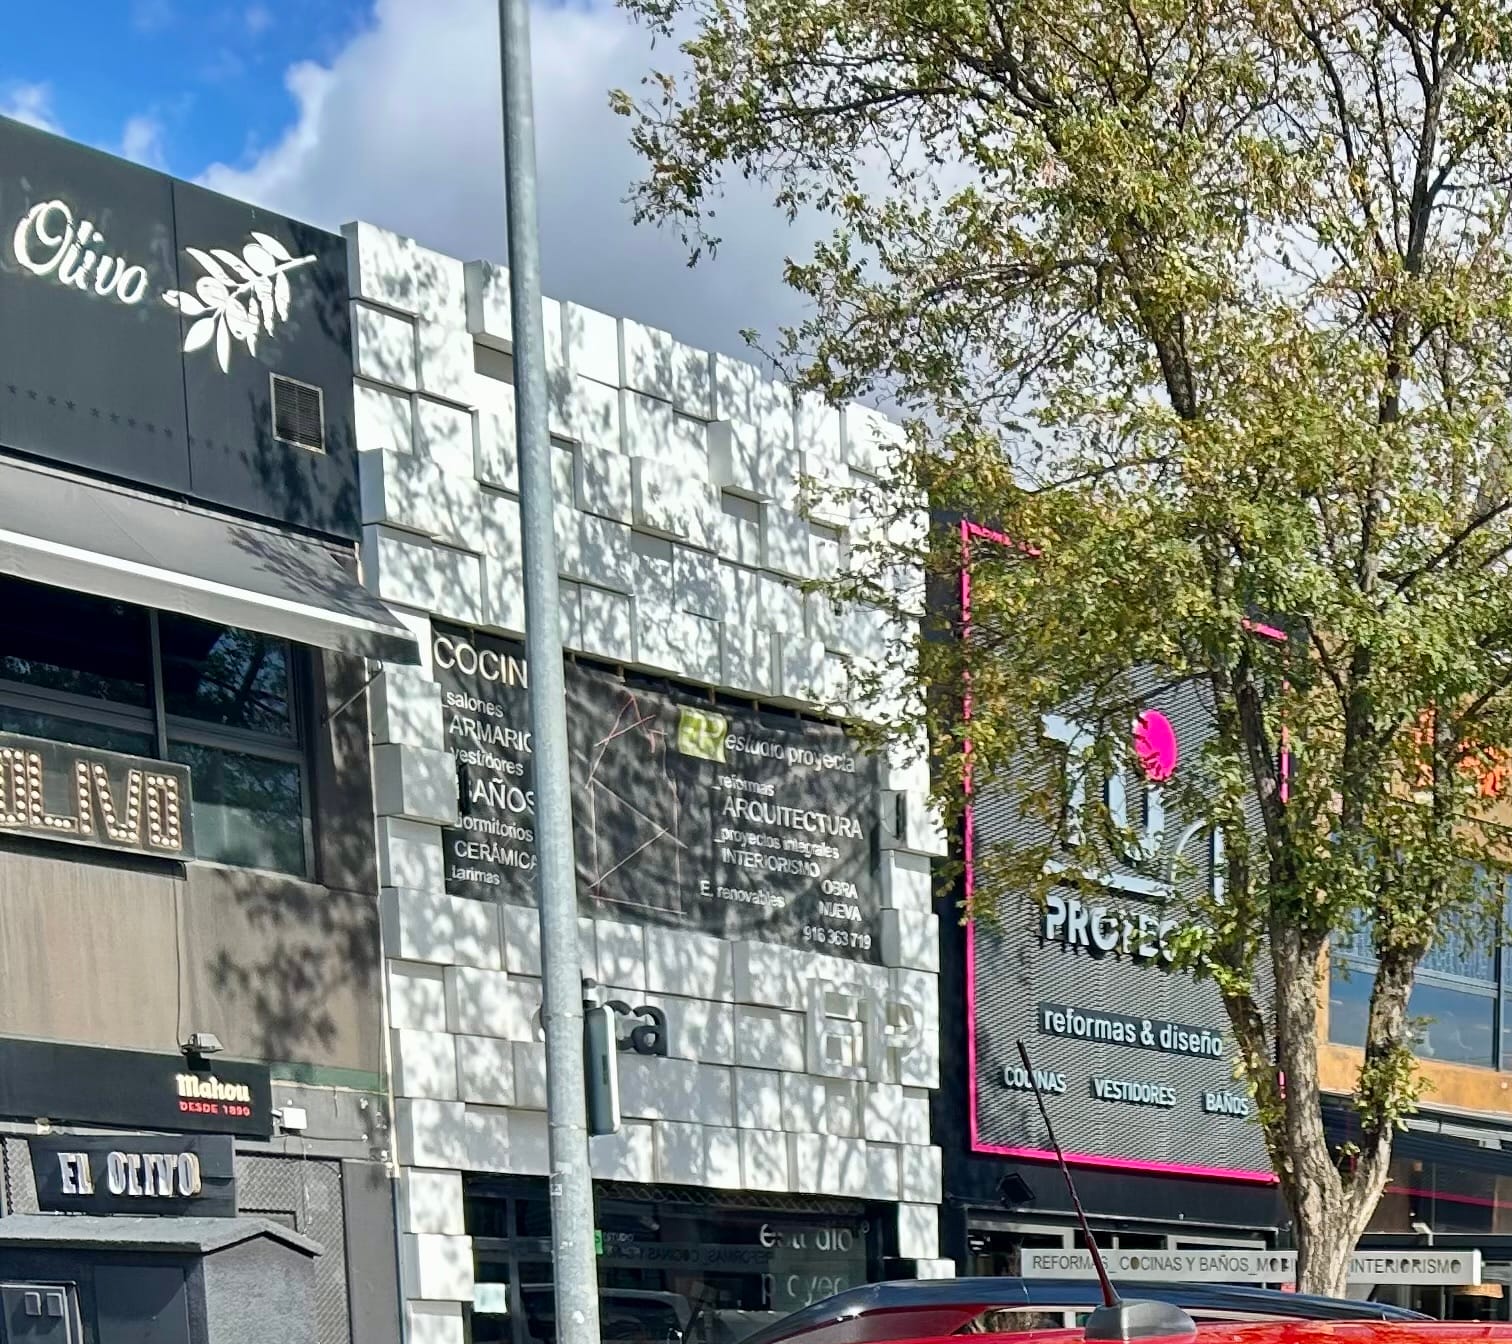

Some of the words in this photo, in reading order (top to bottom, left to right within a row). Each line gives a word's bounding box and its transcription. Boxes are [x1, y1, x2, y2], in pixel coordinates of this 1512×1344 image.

[13, 199, 148, 304] Olivo
[434, 637, 528, 689] COCIN
[450, 715, 533, 752] ARMARI
[468, 778, 535, 815] AÑOS
[722, 796, 864, 840] ARQUITECTURA
[721, 848, 821, 878] INTERIORISMO
[717, 886, 785, 908] renovables
[821, 879, 858, 900] OBRA
[818, 900, 862, 922] NUEVA
[802, 925, 826, 943] 916
[1044, 1008, 1136, 1044] reformas
[1140, 1020, 1155, 1046] &
[1159, 1024, 1224, 1057] diseño
[175, 1073, 251, 1102] Mahou
[1093, 1077, 1177, 1107] VESTIDORES
[1205, 1088, 1250, 1116] BAÑOS
[179, 1101, 218, 1115] DESDE
[222, 1105, 251, 1117] 1890
[57, 1151, 95, 1196] EL
[106, 1150, 202, 1198] OLIVO
[1188, 1257, 1196, 1272] Y
